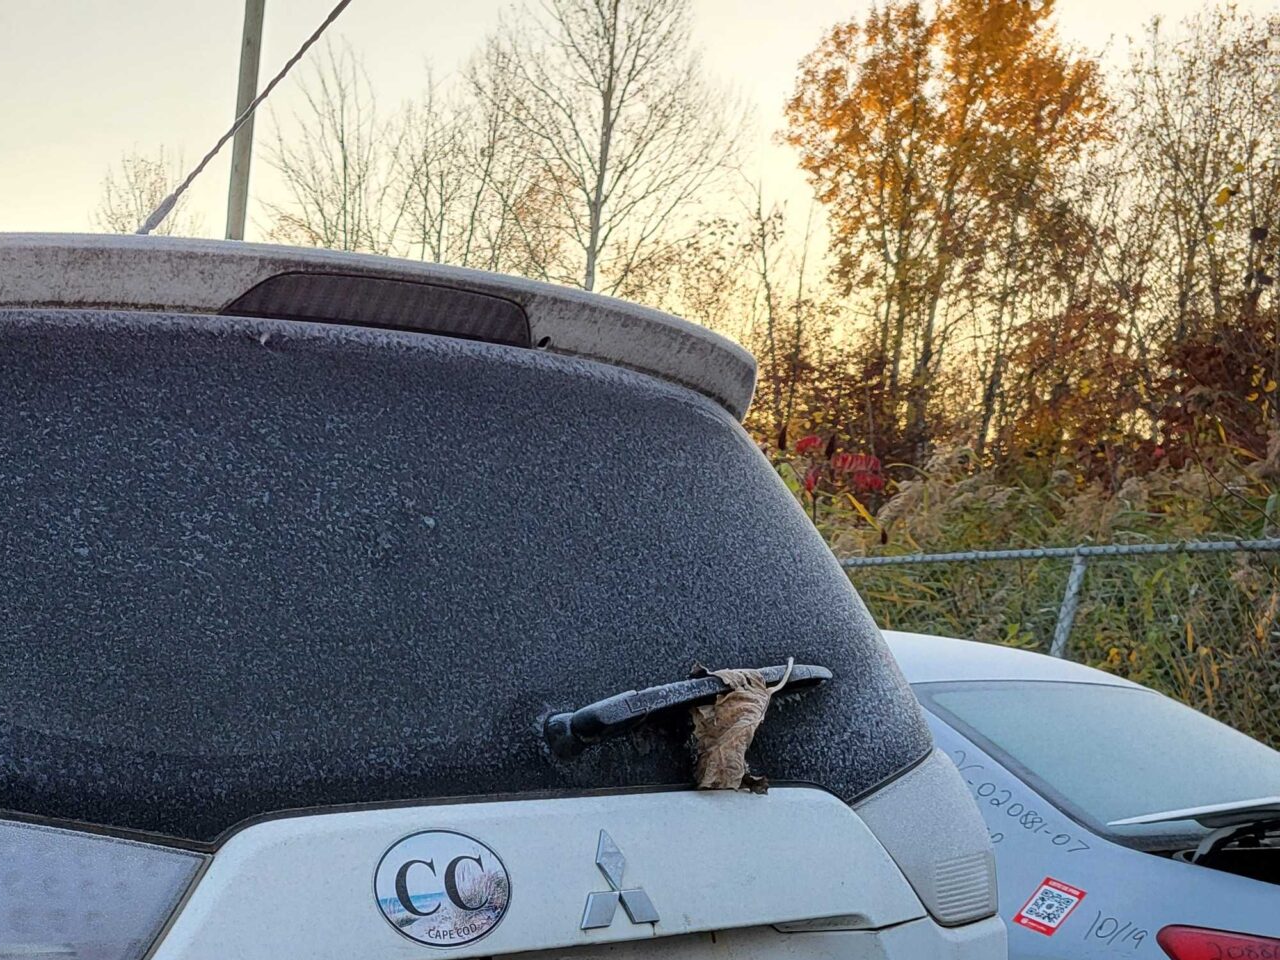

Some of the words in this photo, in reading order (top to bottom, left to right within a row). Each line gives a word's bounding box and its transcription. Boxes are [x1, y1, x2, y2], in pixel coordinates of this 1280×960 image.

[395, 855, 490, 918] CC
[427, 927, 456, 941] CAPE
[456, 923, 478, 939] COD
[1083, 910, 1149, 950] 10/19
